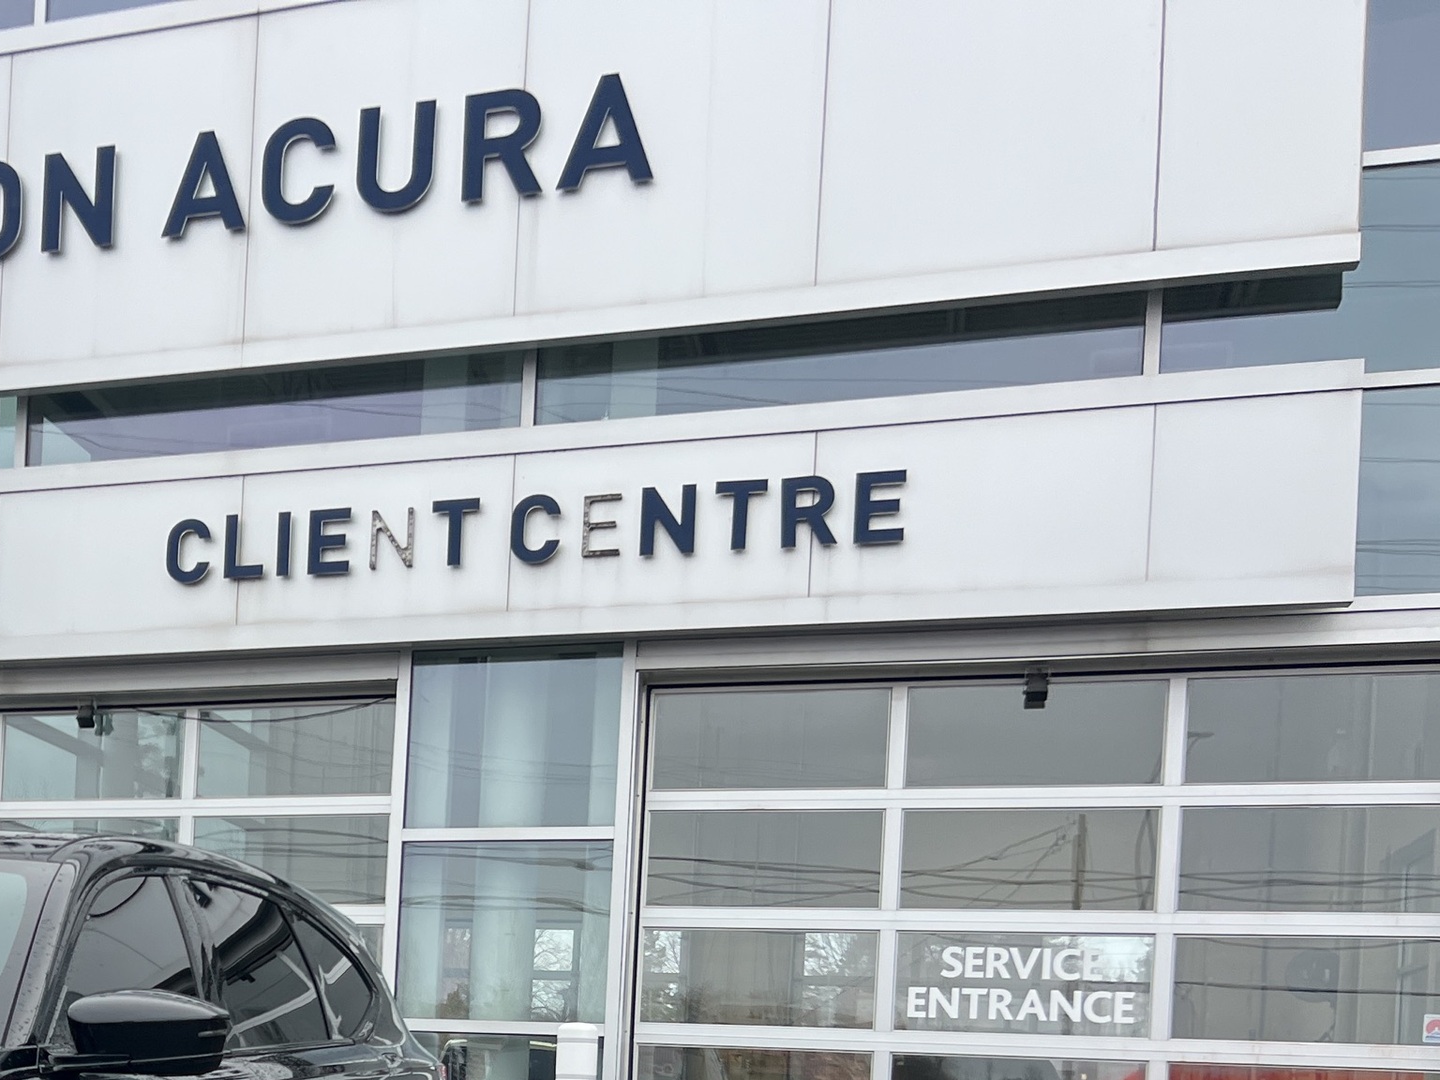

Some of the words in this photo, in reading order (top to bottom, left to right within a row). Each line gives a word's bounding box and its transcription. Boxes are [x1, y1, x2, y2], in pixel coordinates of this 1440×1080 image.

[161, 72, 654, 239] ACURA
[166, 497, 481, 585] CLIENT
[510, 469, 908, 565] CENTRE
[940, 946, 1103, 980] SERVICE
[906, 986, 1137, 1024] ENTRANCE
